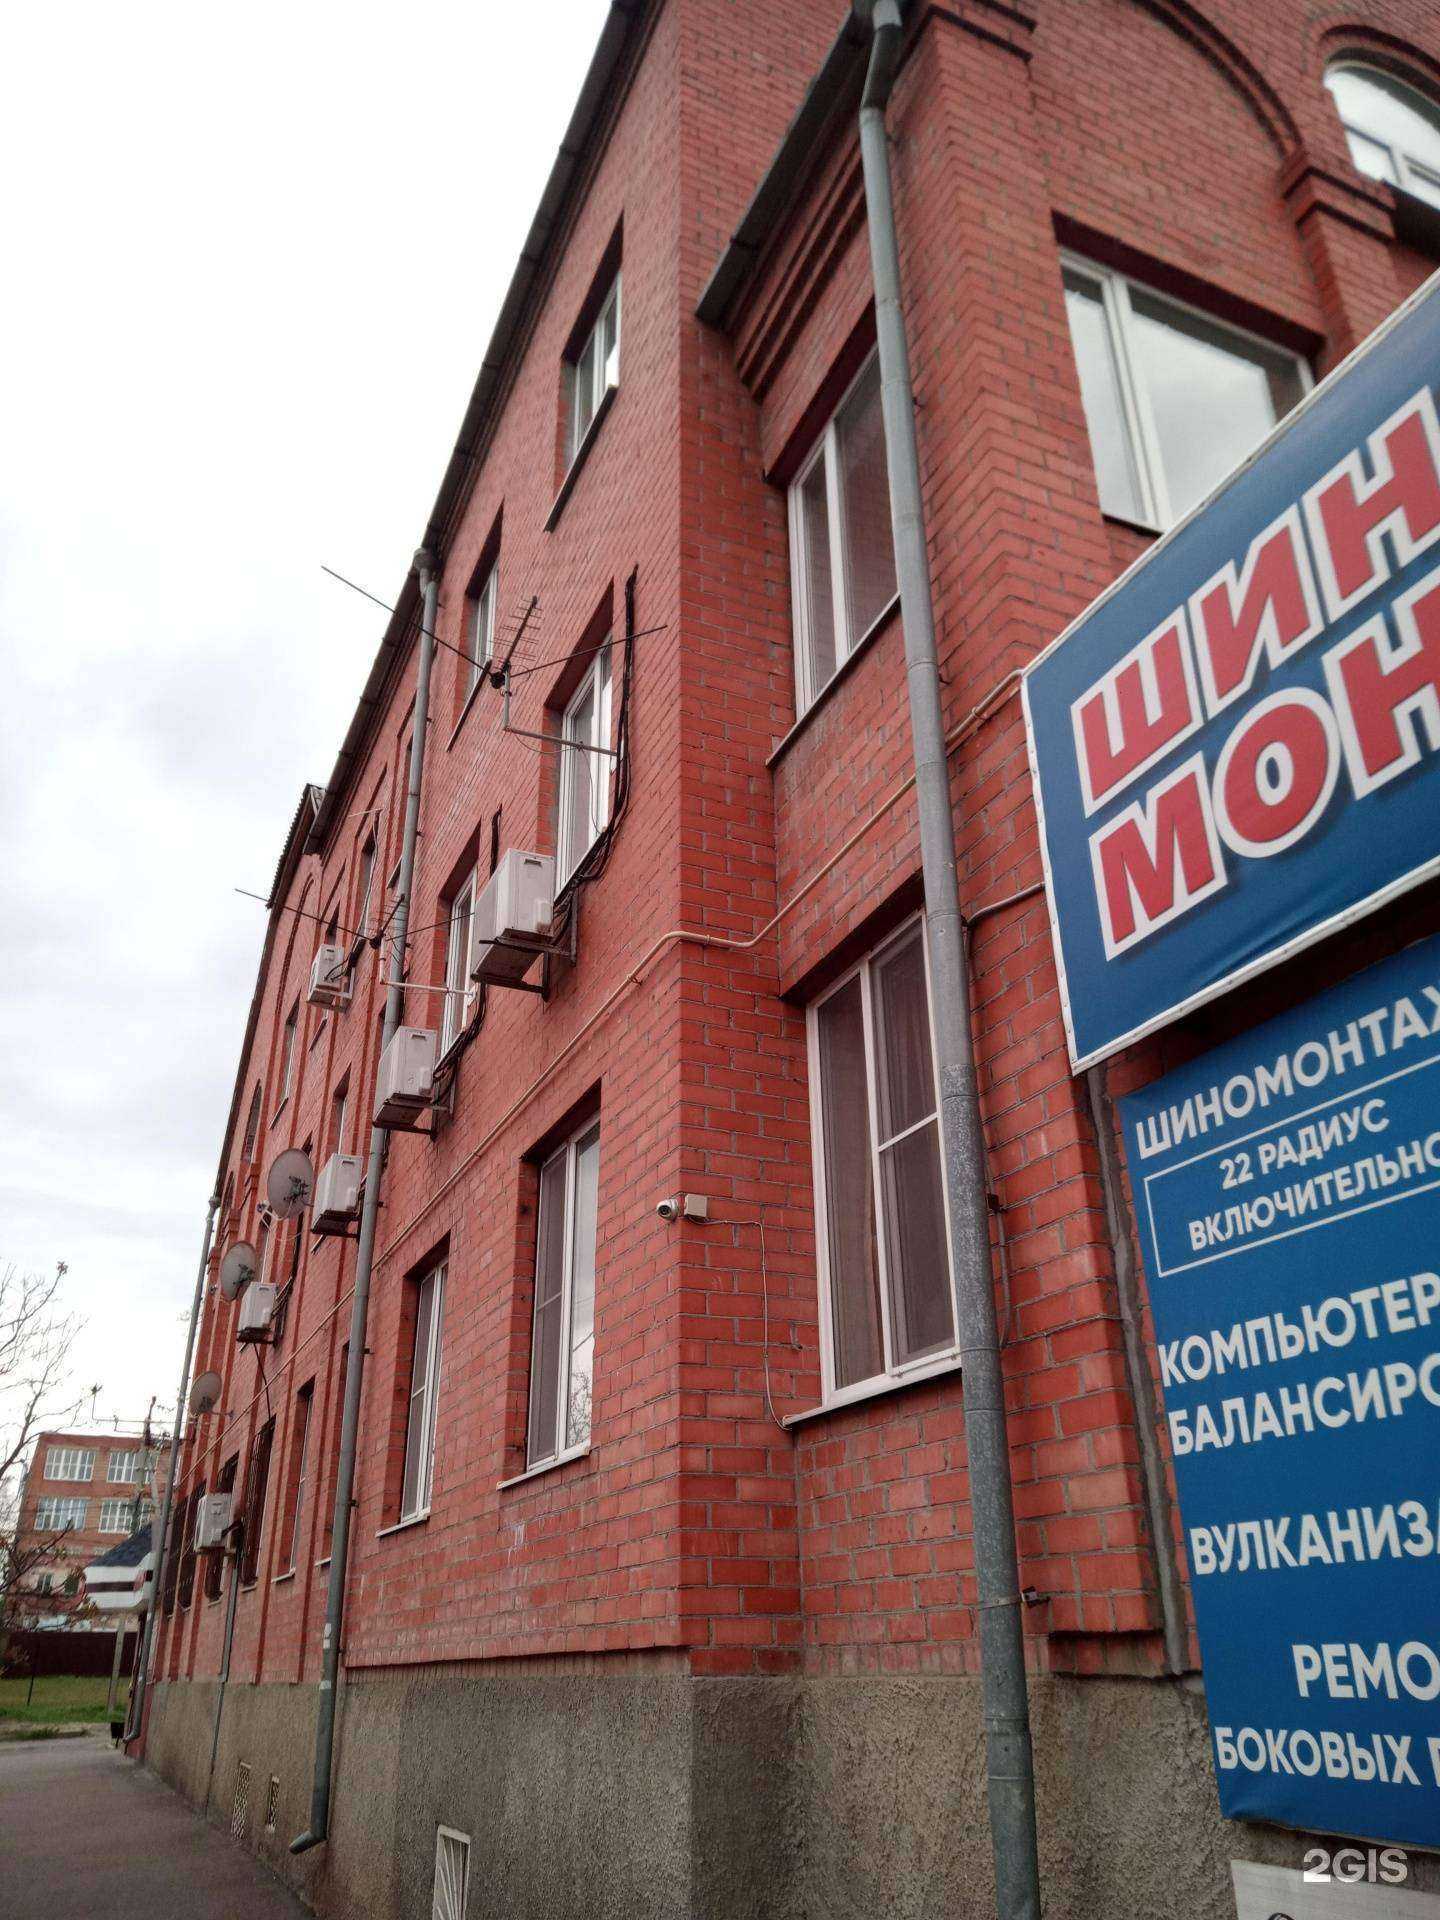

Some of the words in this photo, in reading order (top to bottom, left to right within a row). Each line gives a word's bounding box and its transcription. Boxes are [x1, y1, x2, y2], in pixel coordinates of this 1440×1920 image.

[1219, 1152, 1254, 1189] 22
[1258, 1099, 1390, 1174] РАДИУС
[1158, 1272, 1440, 1388] КОМПЬЮТЕР
[1190, 1499, 1440, 1575] ВУЛКАНИЗ
[1292, 1641, 1440, 1700] РЕМО
[1214, 1726, 1422, 1786] БОКОВЫХ
